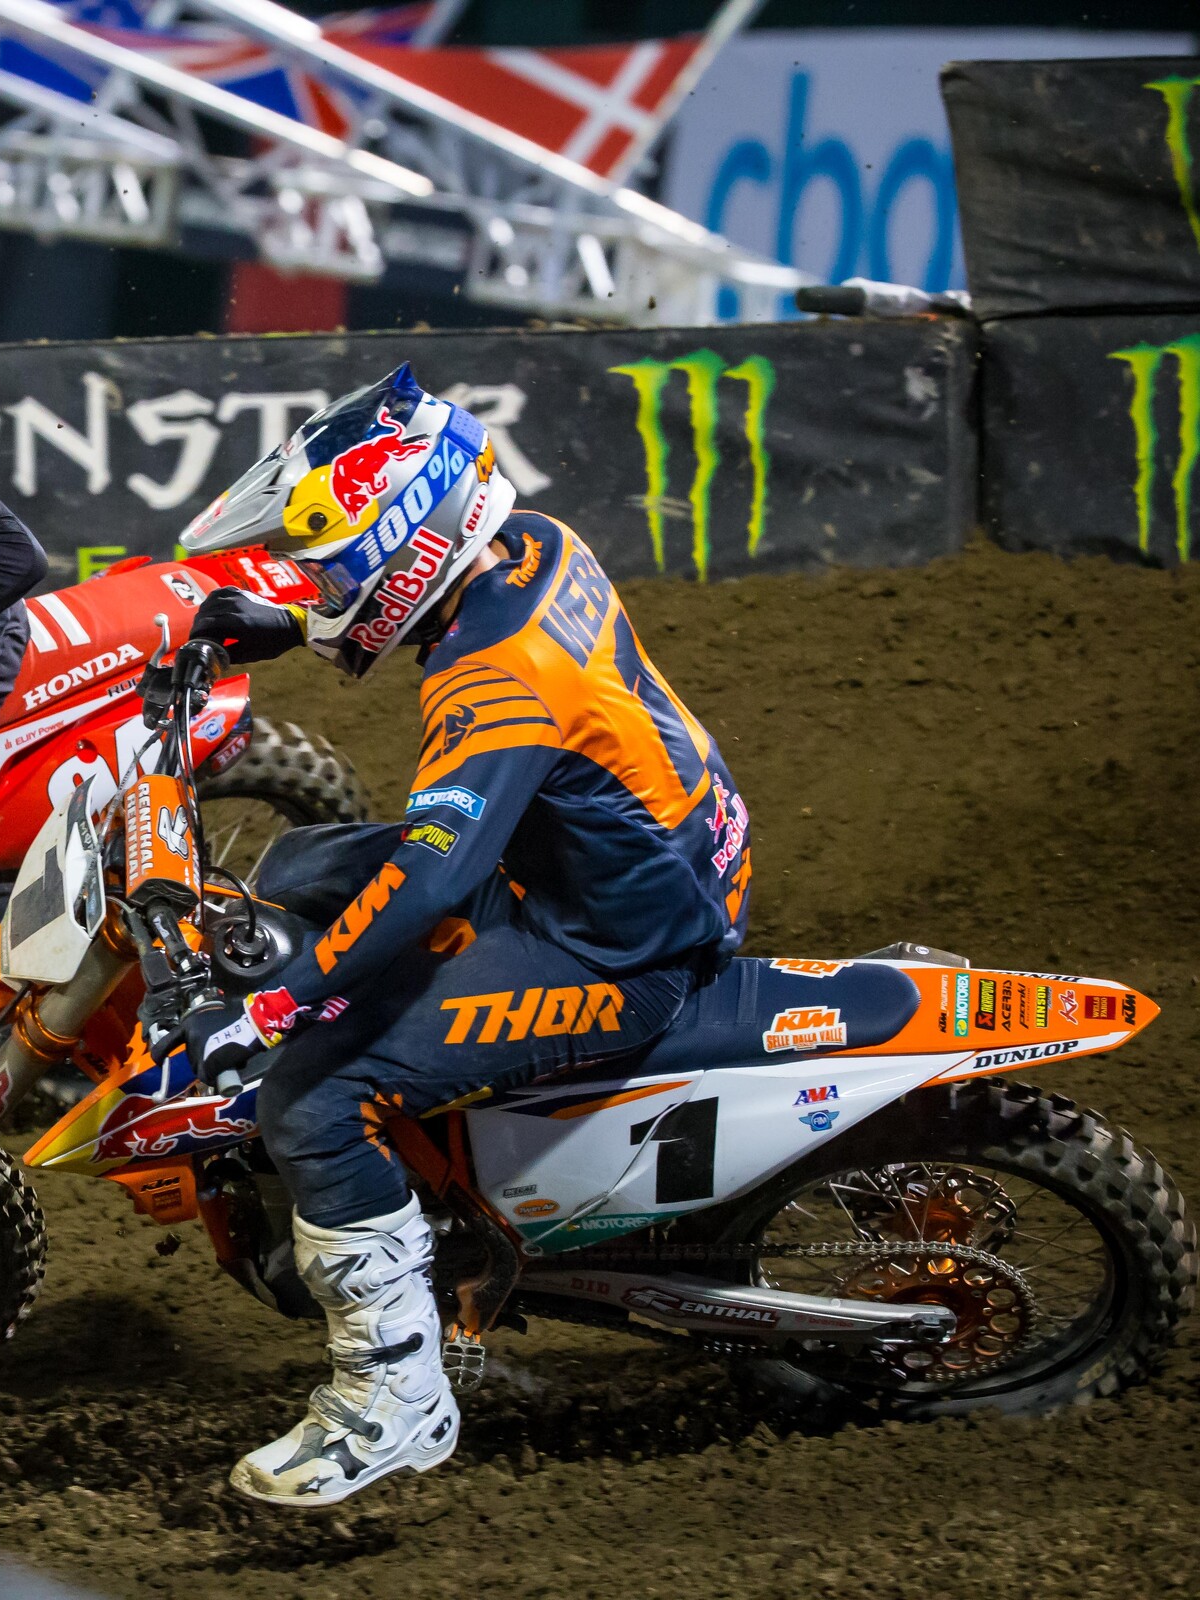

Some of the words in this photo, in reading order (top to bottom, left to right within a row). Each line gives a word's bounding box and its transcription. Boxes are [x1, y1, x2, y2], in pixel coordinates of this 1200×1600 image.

[355, 435, 466, 572] 100%
[464, 493, 487, 533] BELL
[22, 642, 144, 712] HONDA
[414, 789, 477, 813] MOTOREX
[127, 792, 140, 883] RENTHAL
[137, 782, 154, 871] RENTHAL
[314, 861, 408, 976] KTM
[440, 982, 625, 1045] THOR
[956, 975, 969, 1019] MOTOREX
[1036, 986, 1046, 1027] HINSON
[1092, 996, 1100, 1018] WELLS
[1122, 994, 1136, 1026] KTM
[766, 1034, 790, 1050] SELLE
[820, 1027, 844, 1042] VALLE
[774, 1008, 836, 1032] KTM
[972, 1040, 1079, 1069] DUNLOP
[792, 1085, 840, 1107] AMA
[631, 1097, 720, 1205] 1
[581, 1216, 655, 1231] MOTOREX
